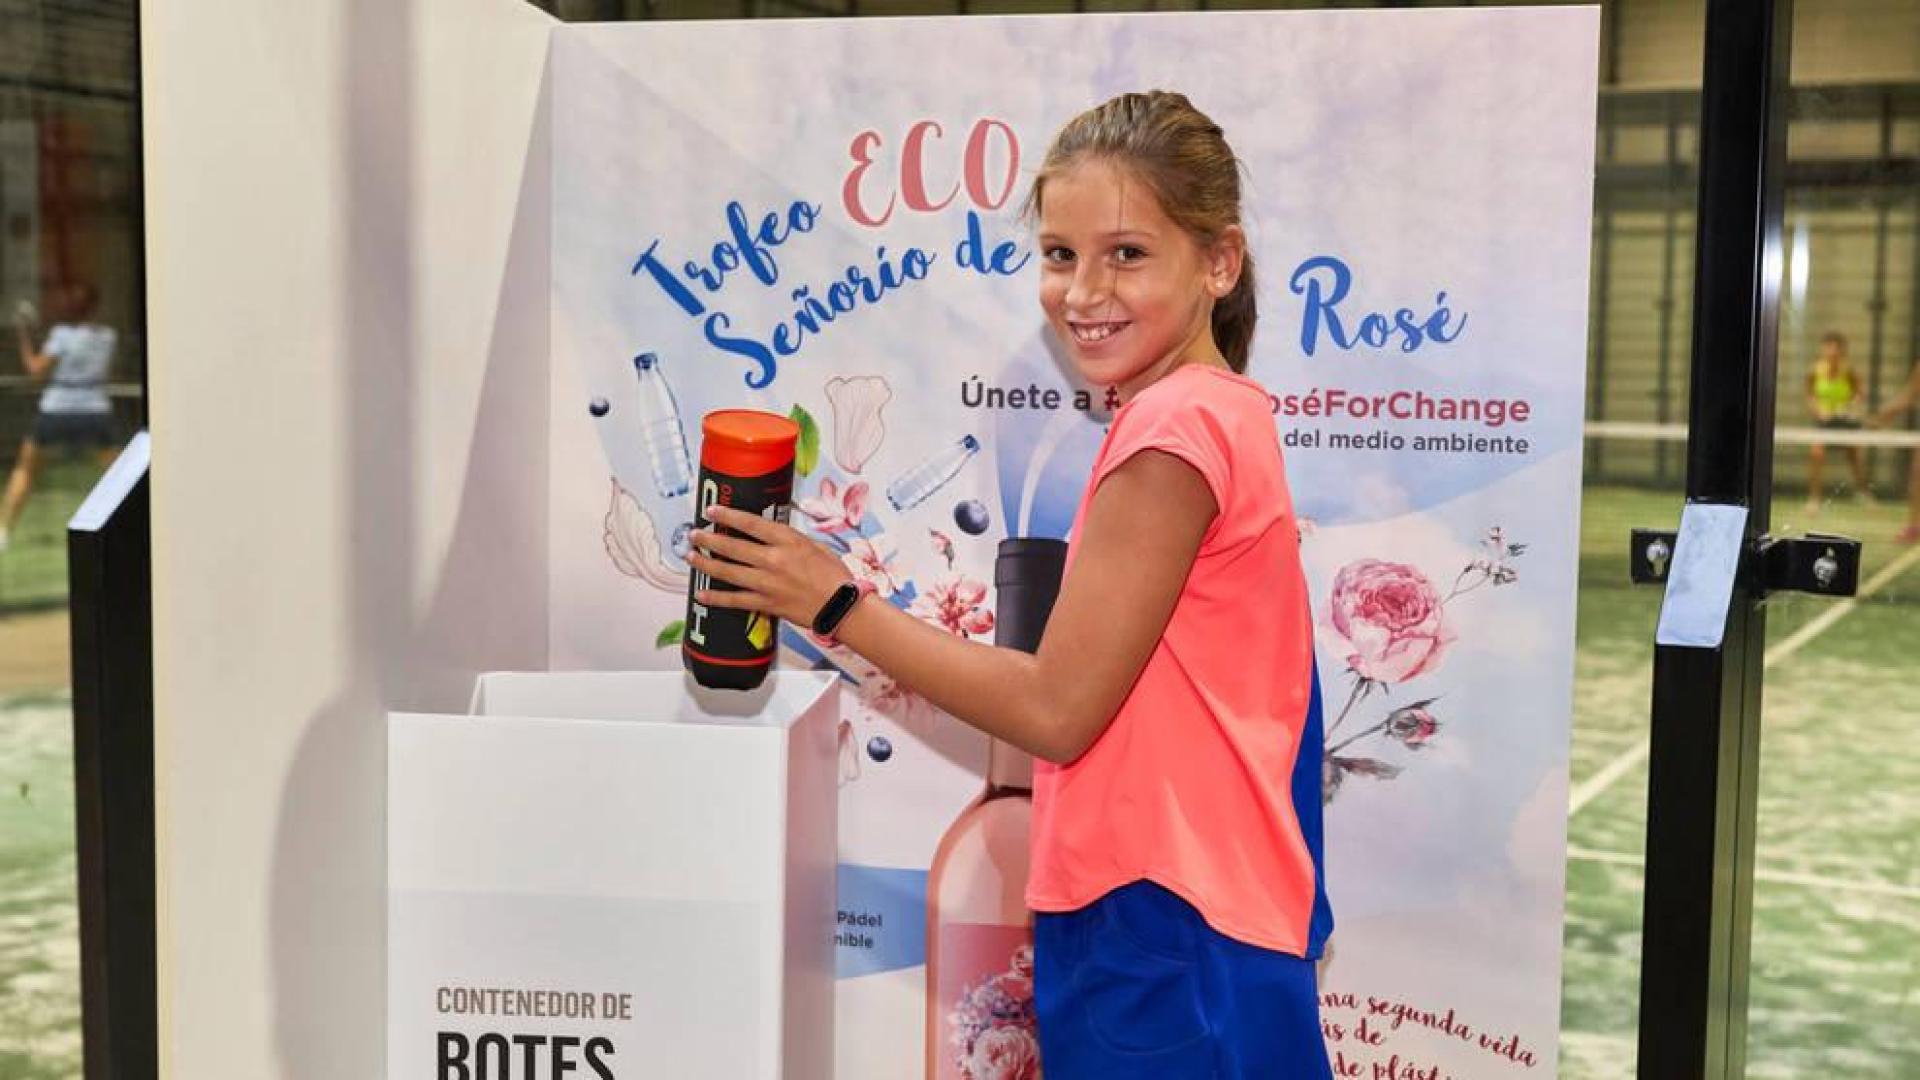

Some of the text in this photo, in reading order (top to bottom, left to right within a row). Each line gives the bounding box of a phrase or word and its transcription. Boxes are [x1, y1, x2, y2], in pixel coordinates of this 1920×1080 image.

[632, 118, 1021, 316] Trofeo ECO
[956, 210, 1032, 276] de
[1290, 256, 1468, 356] Rosé
[961, 375, 1061, 410] Únete
[1073, 389, 1091, 411] a
[1284, 428, 1529, 454] del medio ambiente
[437, 986, 633, 1020] CONTENEDOR DE
[1353, 1016, 1388, 1046] de
[1368, 996, 1474, 1041] segunda
[1478, 1033, 1537, 1068] vida
[437, 1031, 616, 1080] BOTES
